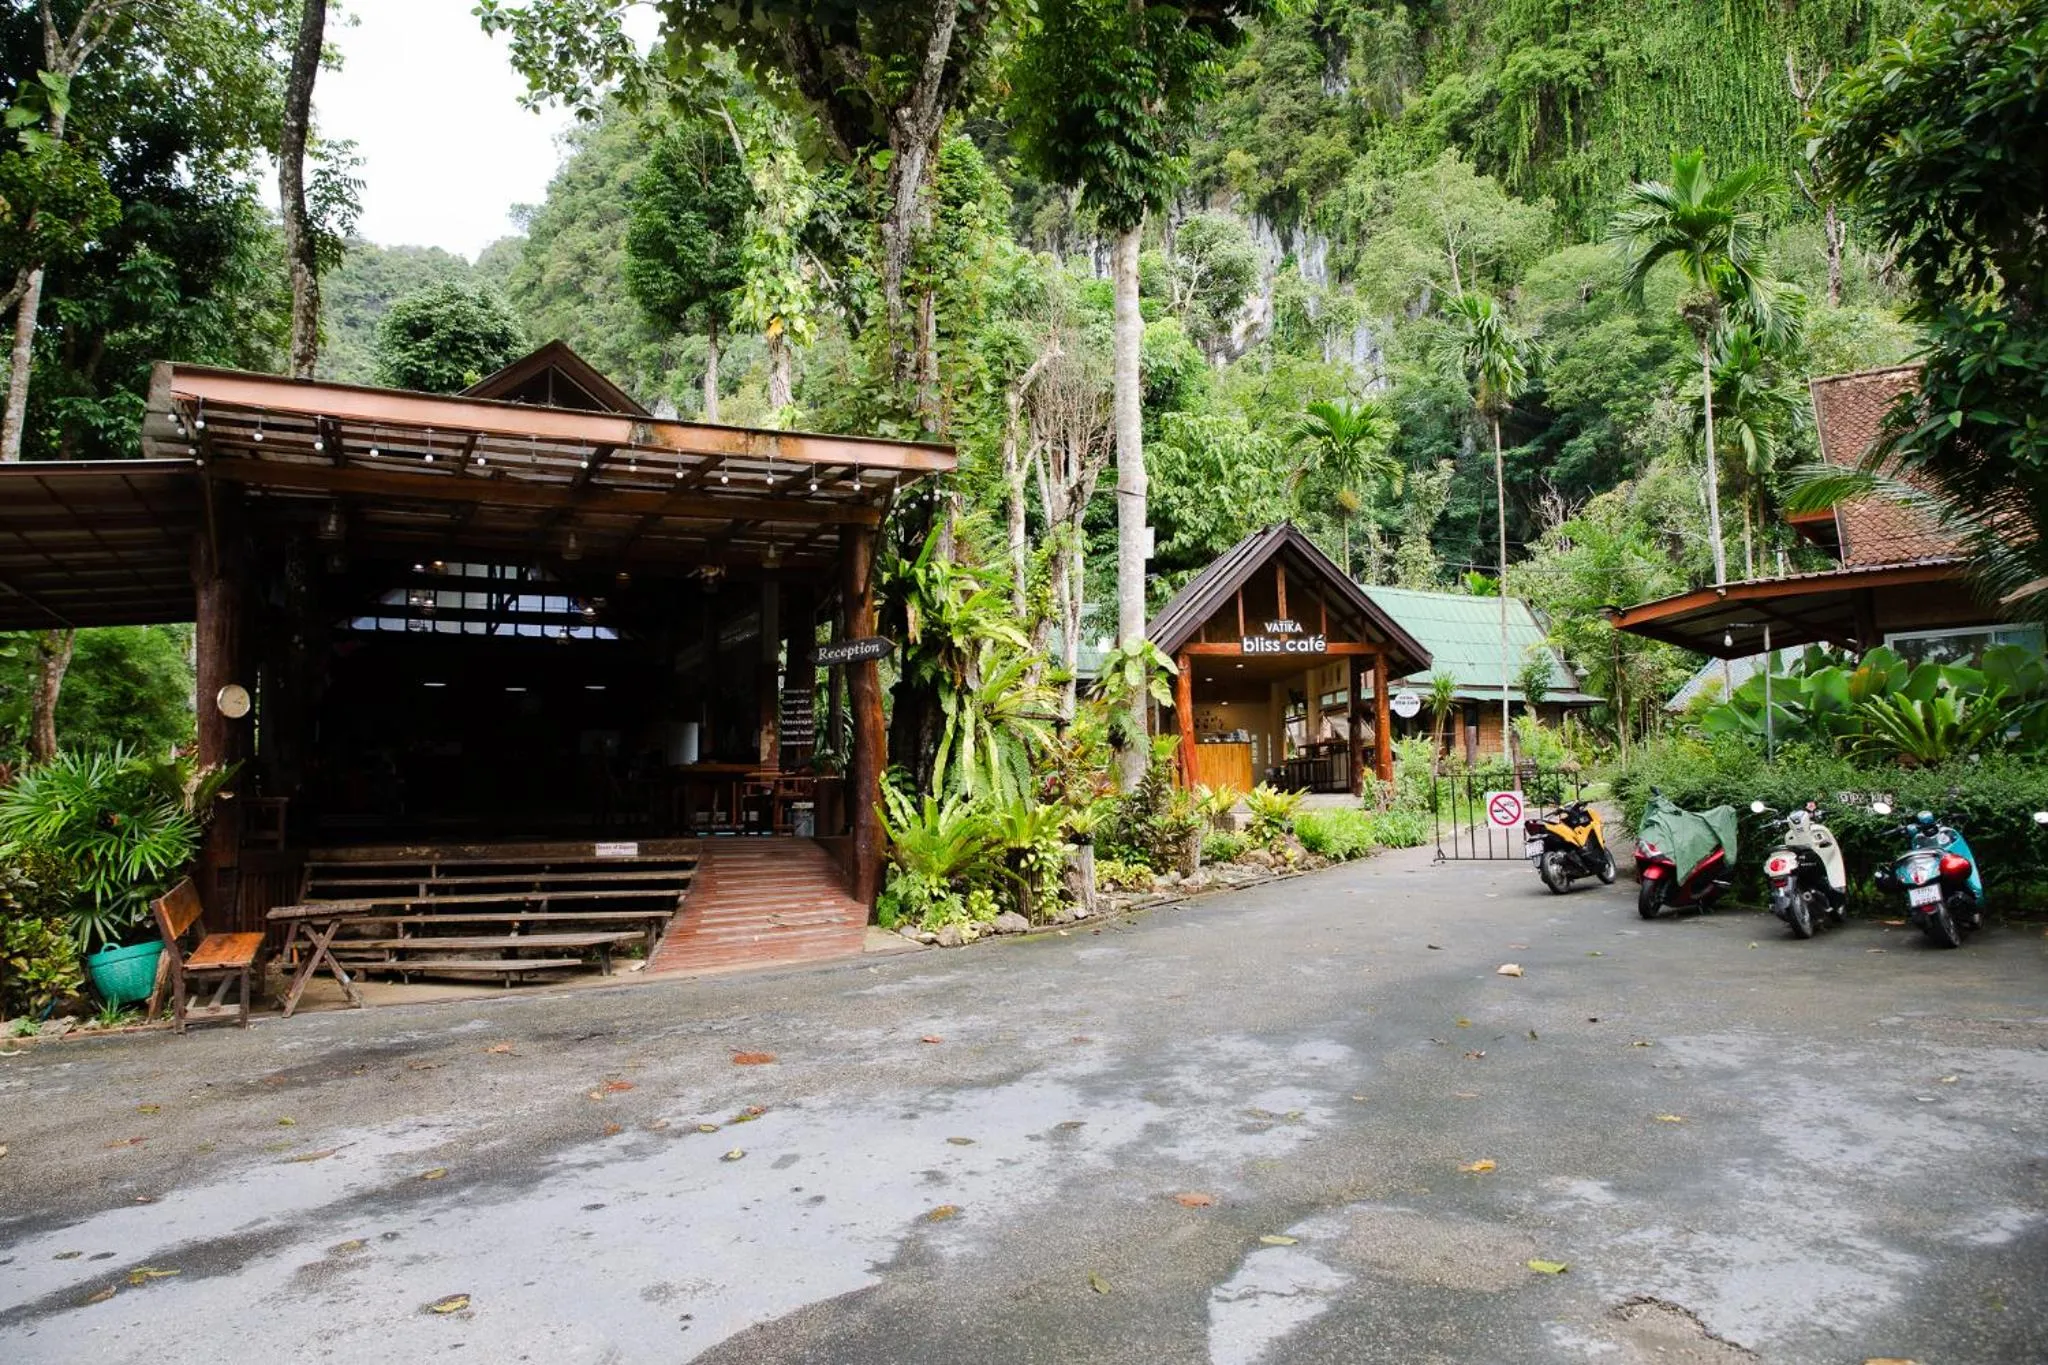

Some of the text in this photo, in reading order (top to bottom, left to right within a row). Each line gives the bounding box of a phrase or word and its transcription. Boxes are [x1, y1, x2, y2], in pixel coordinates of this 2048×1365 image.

[1264, 622, 1304, 633] VATIKA
[818, 641, 880, 661] Reception
[1243, 634, 1326, 652] bliss café
